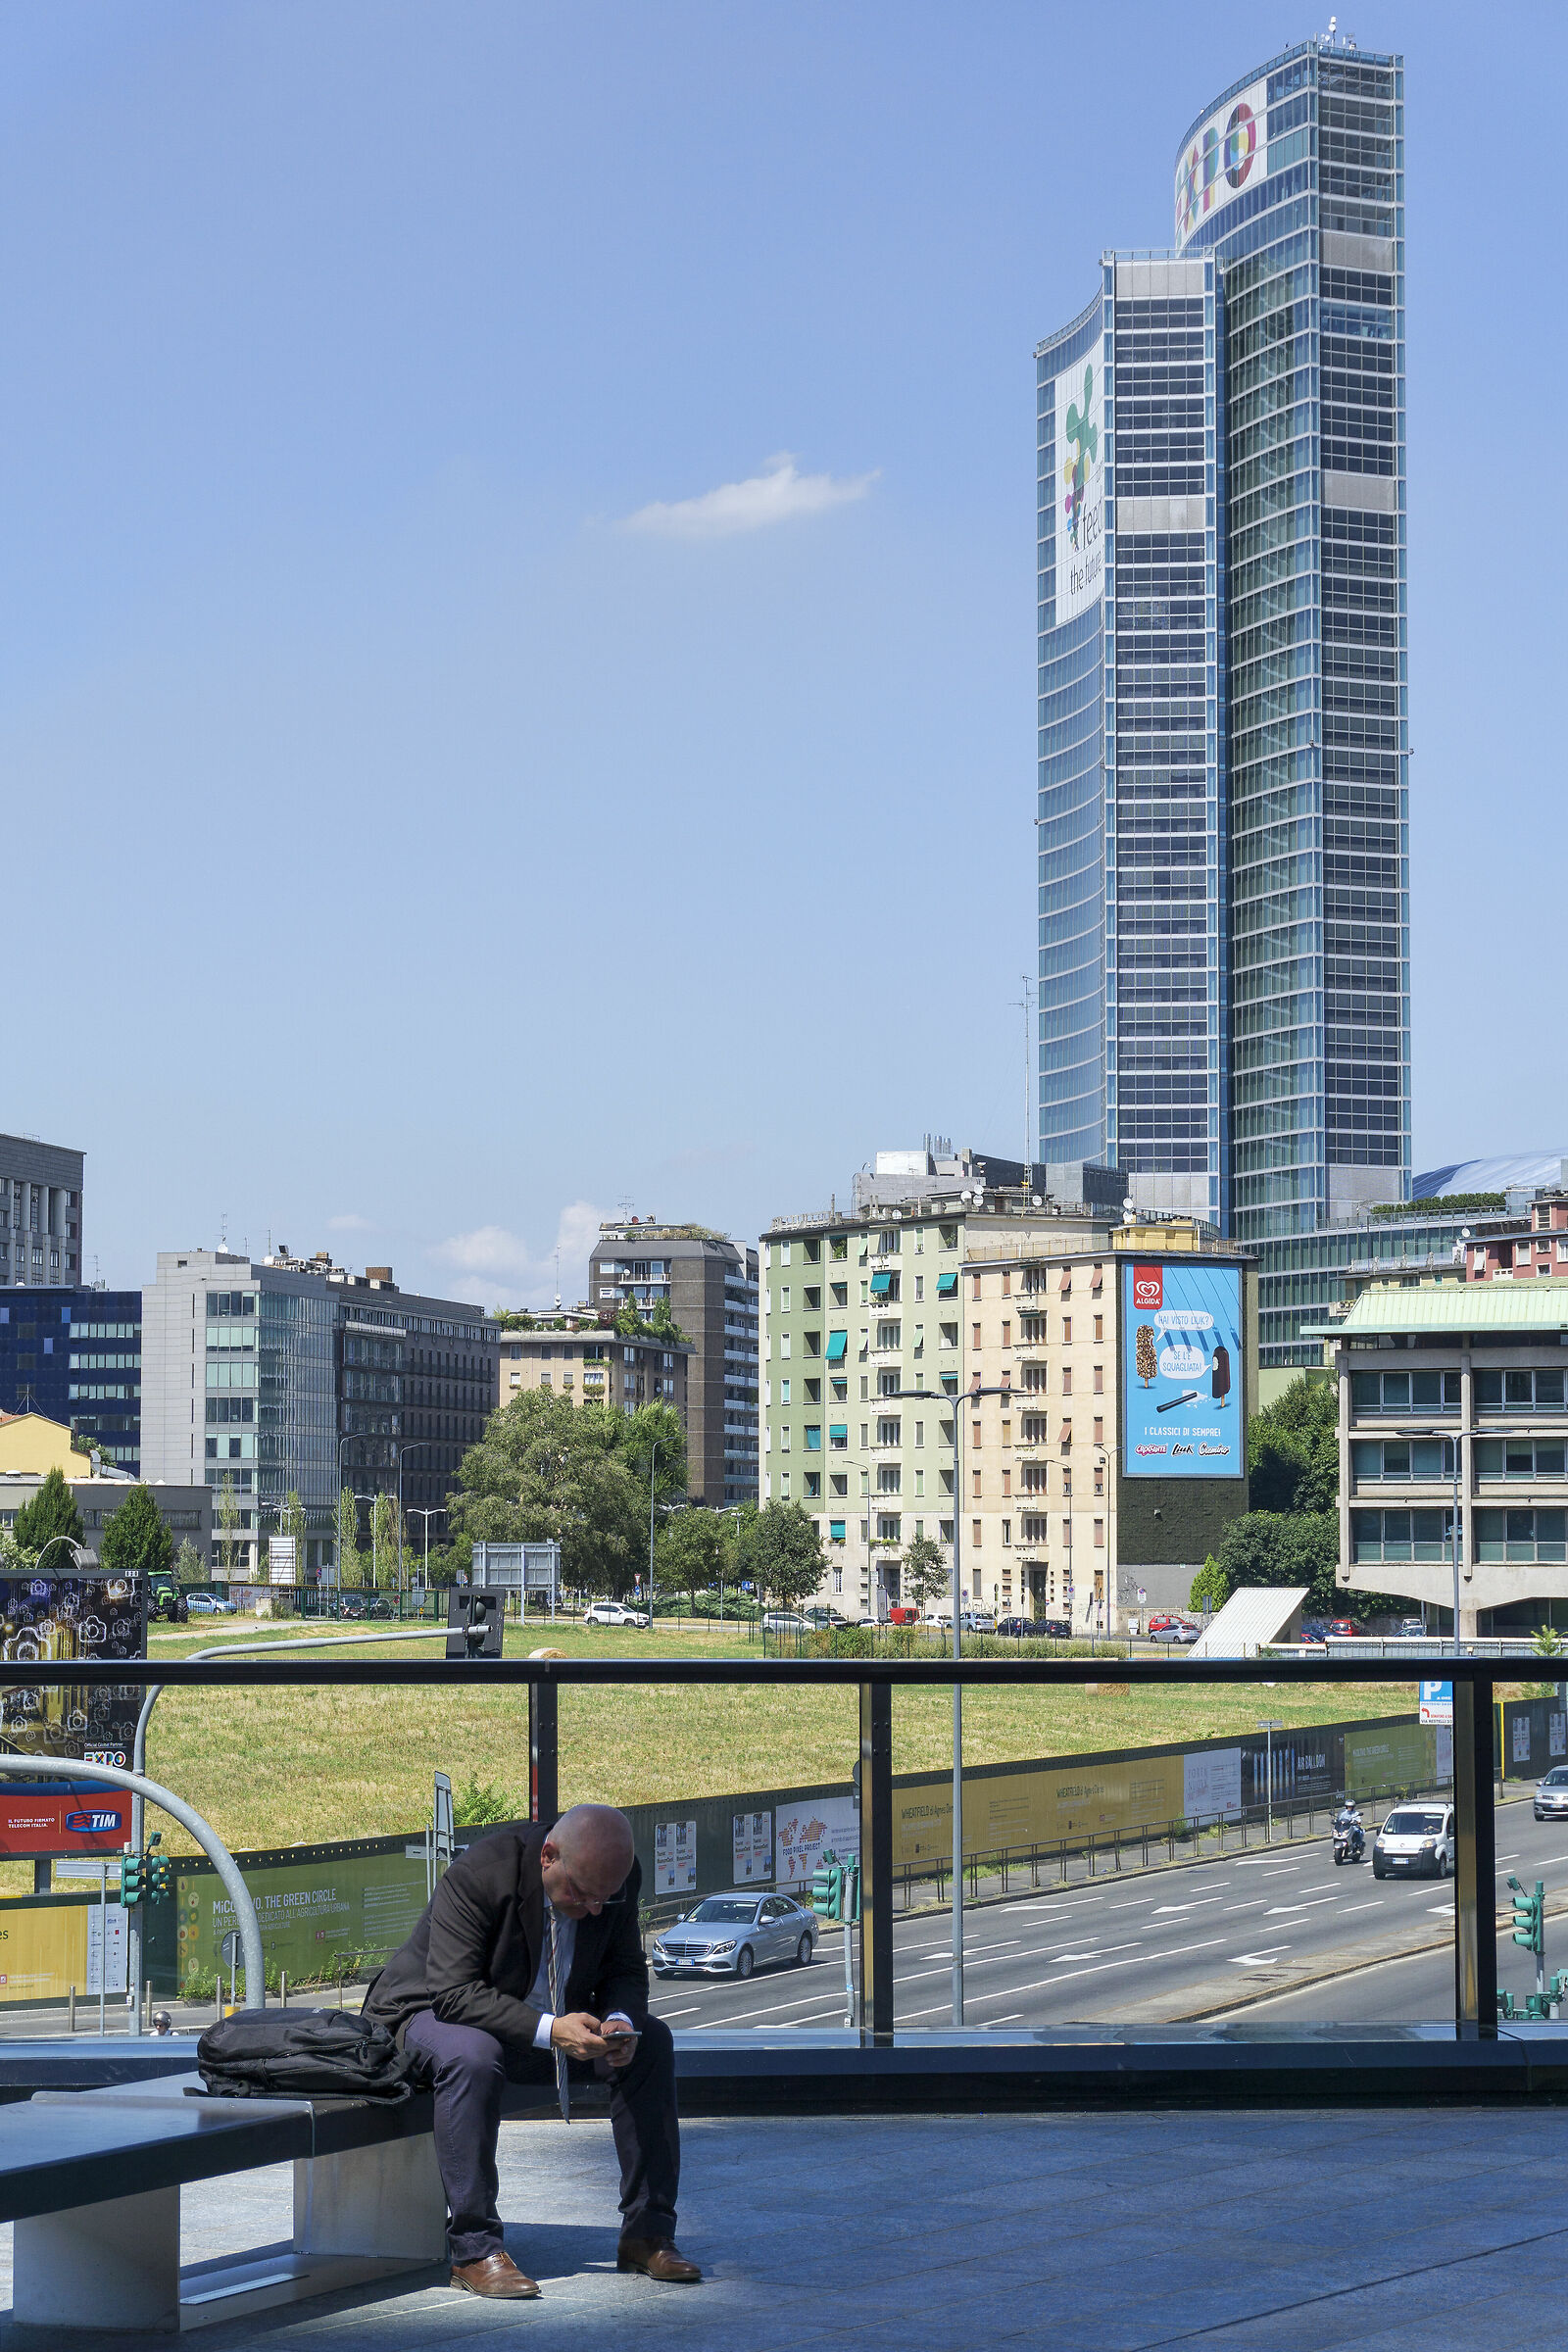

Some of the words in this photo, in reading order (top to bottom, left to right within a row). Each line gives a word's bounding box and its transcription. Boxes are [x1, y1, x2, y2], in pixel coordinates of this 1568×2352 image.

[1070, 564, 1084, 595] the
[1158, 1315, 1168, 1325] HAI
[1172, 1315, 1188, 1325] VISTO
[1173, 1350, 1181, 1360] SE
[1150, 1427, 1181, 1436] CLASSICI
[1424, 1681, 1443, 1700] P
[83, 1750, 126, 1767] EXPO
[92, 1814, 116, 1828] TIM
[265, 1894, 282, 1909] THE
[283, 1891, 312, 1907] GREEN
[312, 1887, 337, 1903] CIRCLE
[212, 1917, 222, 1928] UN
